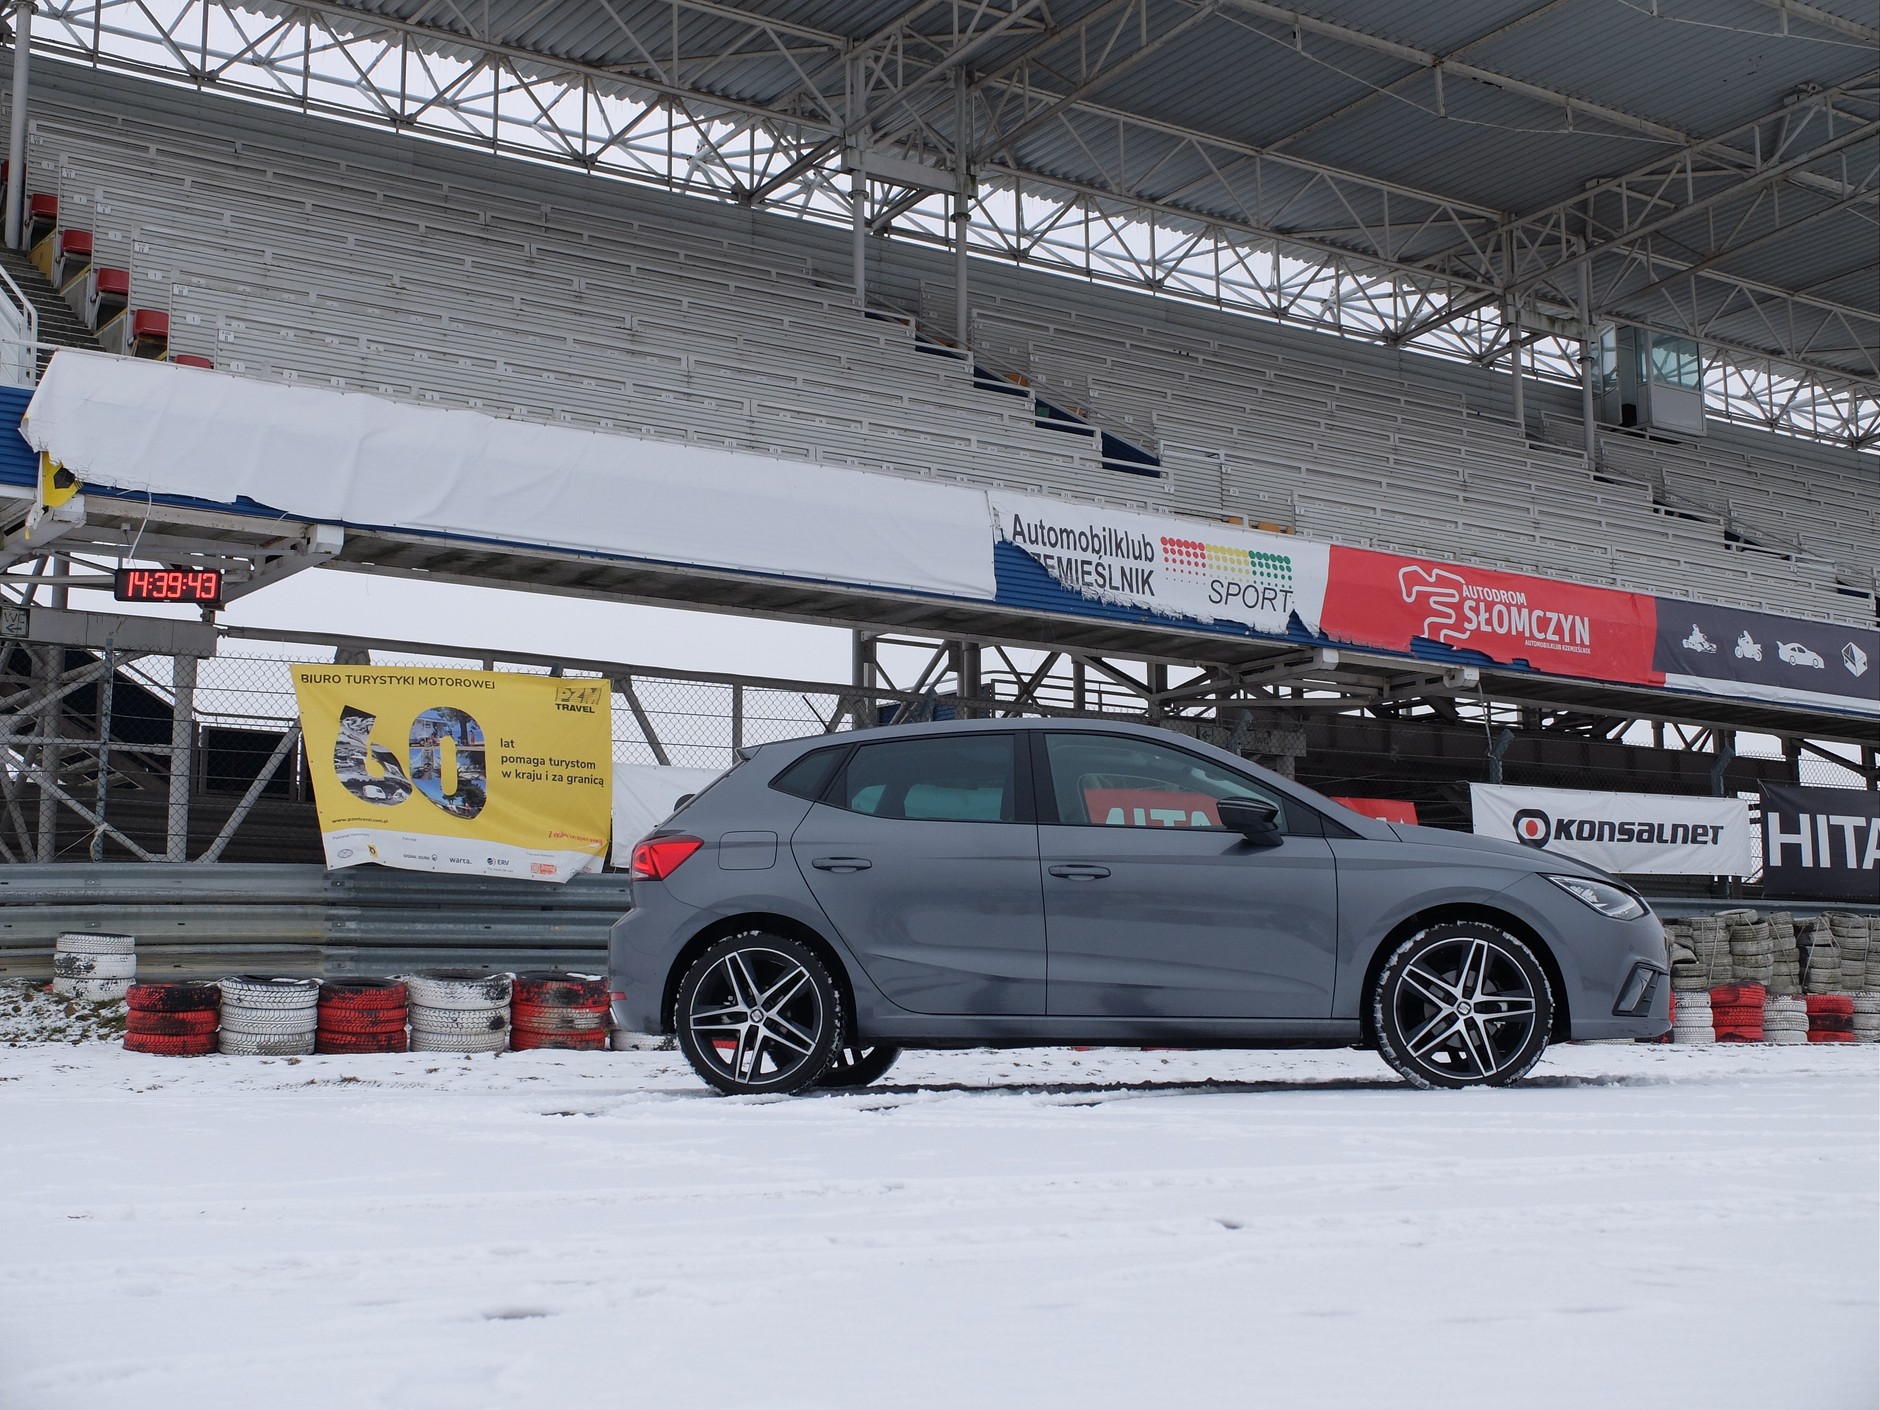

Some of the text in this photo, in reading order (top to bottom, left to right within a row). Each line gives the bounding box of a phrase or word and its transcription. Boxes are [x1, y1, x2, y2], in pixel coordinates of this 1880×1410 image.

[1012, 513, 1155, 563] Automobilklub
[128, 571, 217, 598] 14:39:43
[1462, 584, 1527, 606] AUTODROM
[1208, 579, 1294, 613] SPORT
[1463, 600, 1590, 646] SŁOMCZYN
[301, 674, 496, 689] BIURO TURYSTYKI MOTOROWEJ
[555, 703, 595, 714] TRAVEL
[500, 738, 515, 748] lat
[334, 705, 487, 820] 60
[501, 755, 596, 769] pomaga turystom
[501, 769, 604, 787] w kraju i za granicą
